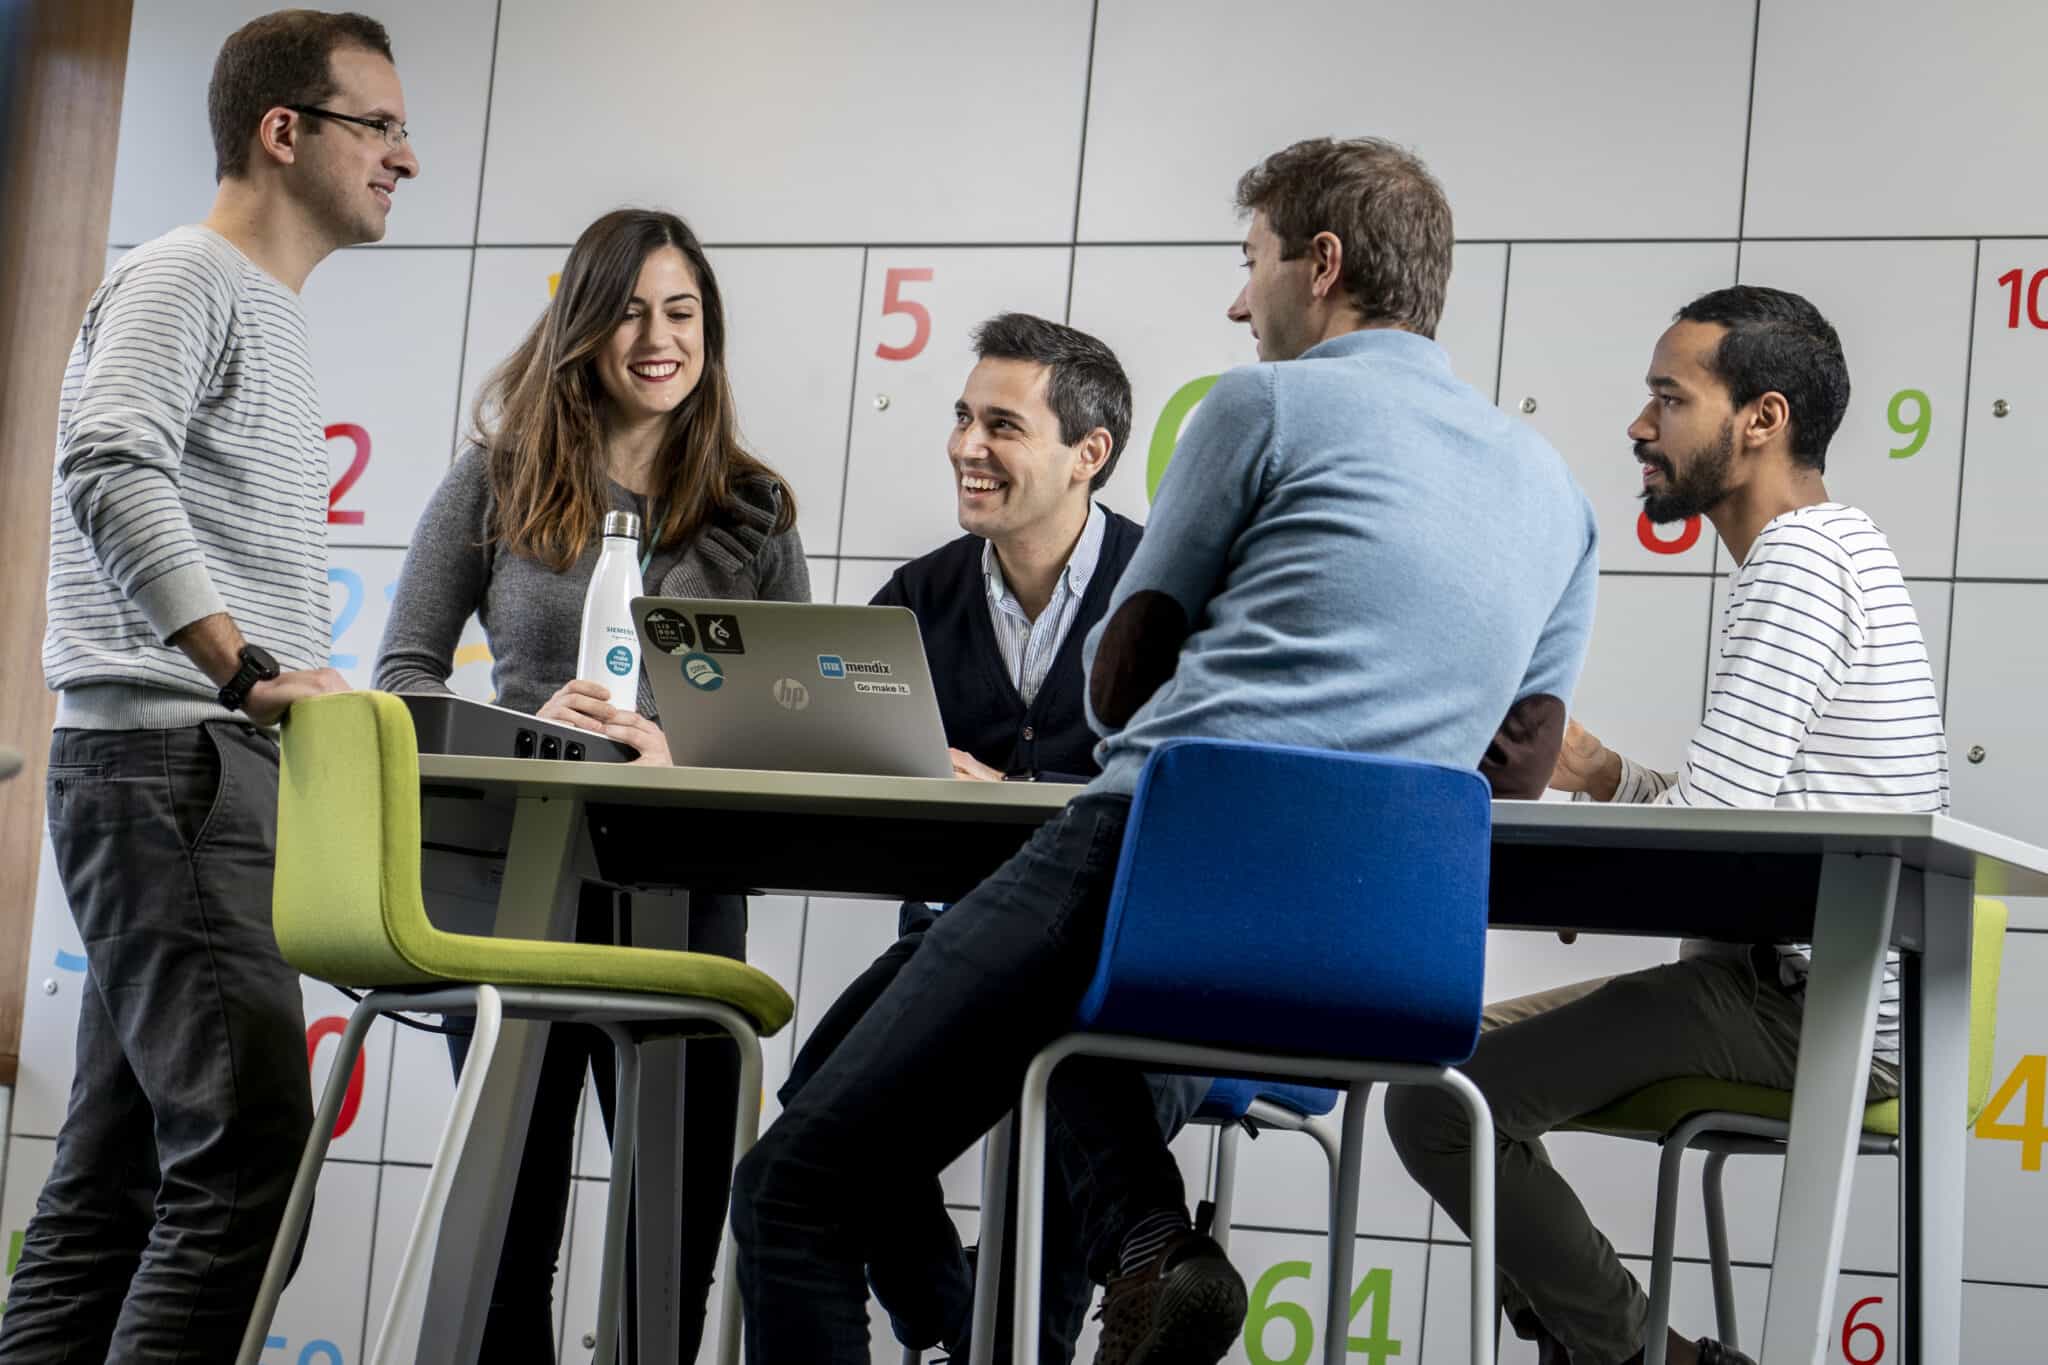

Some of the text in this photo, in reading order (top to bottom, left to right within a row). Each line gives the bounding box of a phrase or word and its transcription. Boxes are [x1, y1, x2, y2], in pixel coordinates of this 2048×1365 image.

[874, 268, 935, 361] 5
[1887, 388, 1931, 459] 9
[323, 423, 371, 525] 2
[845, 661, 891, 674] mendix
[857, 683, 870, 691] Go
[872, 684, 897, 693] make
[1975, 1054, 2048, 1172] 4
